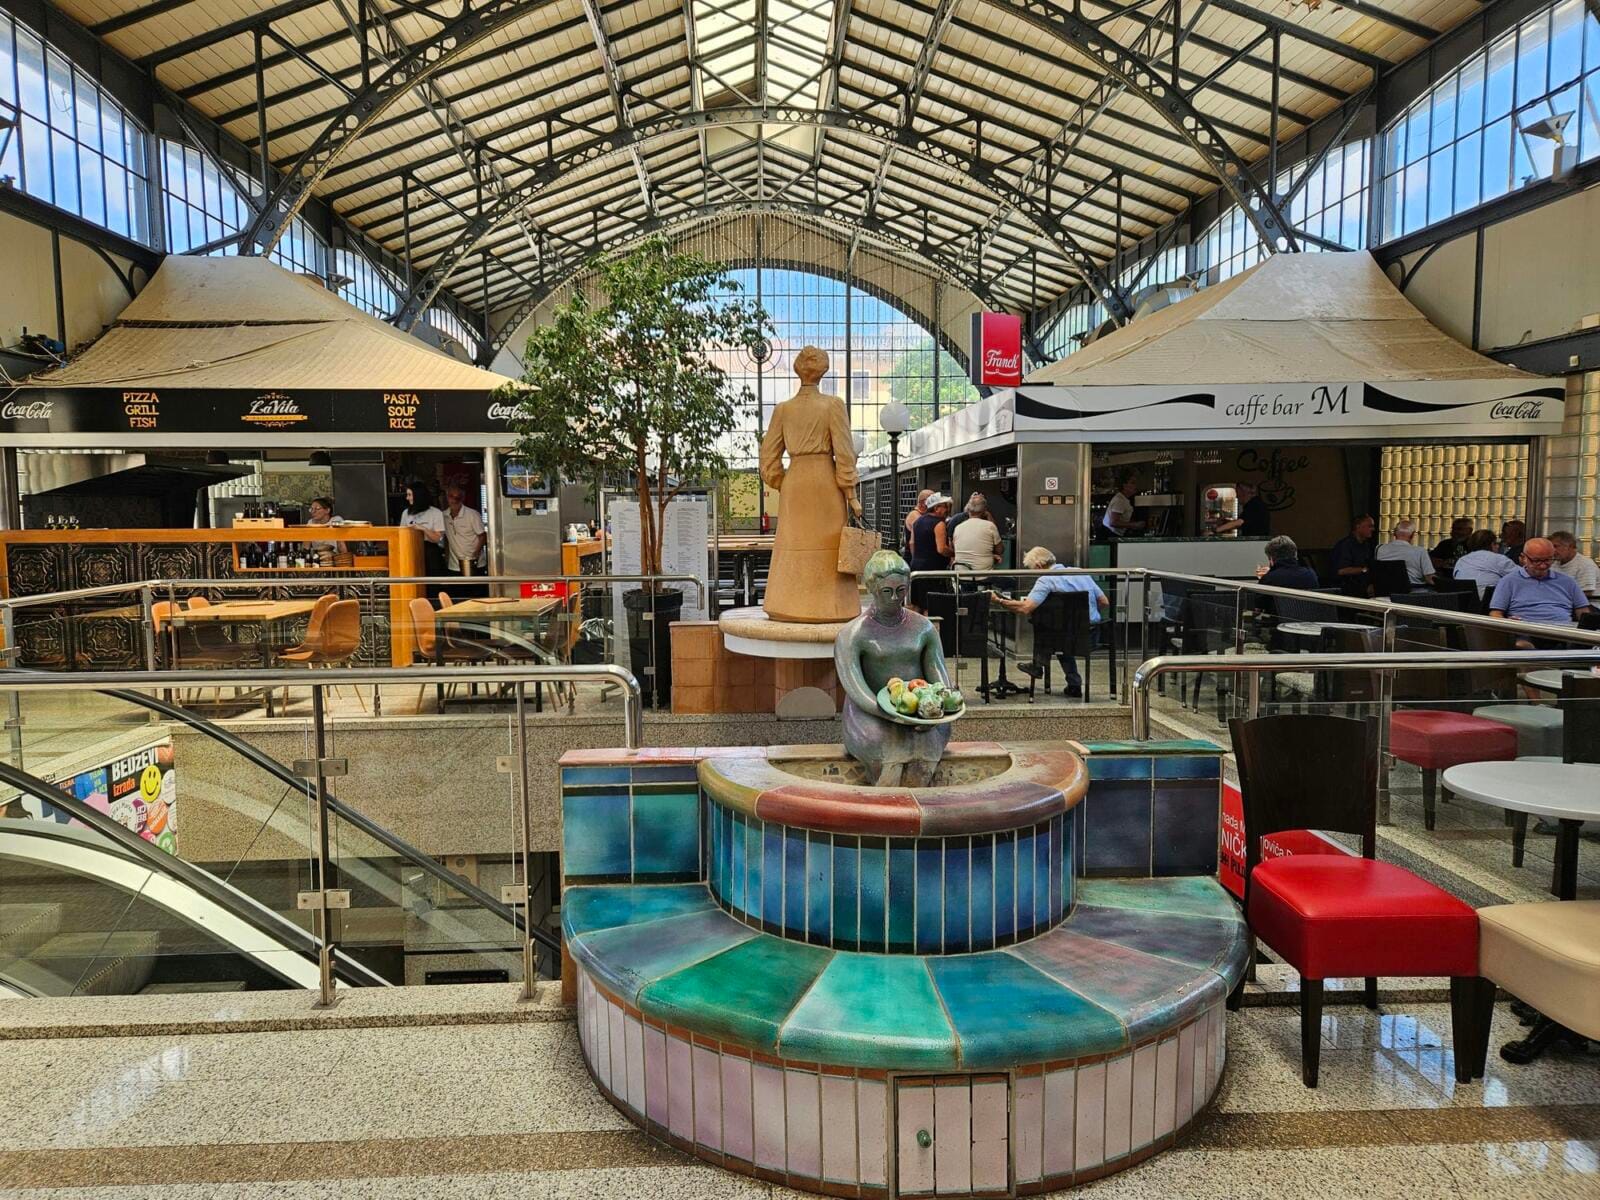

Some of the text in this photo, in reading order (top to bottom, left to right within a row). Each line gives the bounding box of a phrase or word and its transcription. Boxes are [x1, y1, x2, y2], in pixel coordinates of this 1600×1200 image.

[985, 349, 1020, 369] Franck
[123, 392, 160, 403] PIZZA
[383, 393, 420, 405] PASTA
[1, 401, 54, 419] Coca-Cola
[125, 404, 160, 415] GRILL
[387, 406, 417, 417] SOUP
[1225, 385, 1350, 426] caffe bar M
[1489, 400, 1545, 420] Coca-Cola
[129, 417, 157, 428] FISH
[389, 418, 416, 429] RICE
[1236, 448, 1310, 481] Coffee
